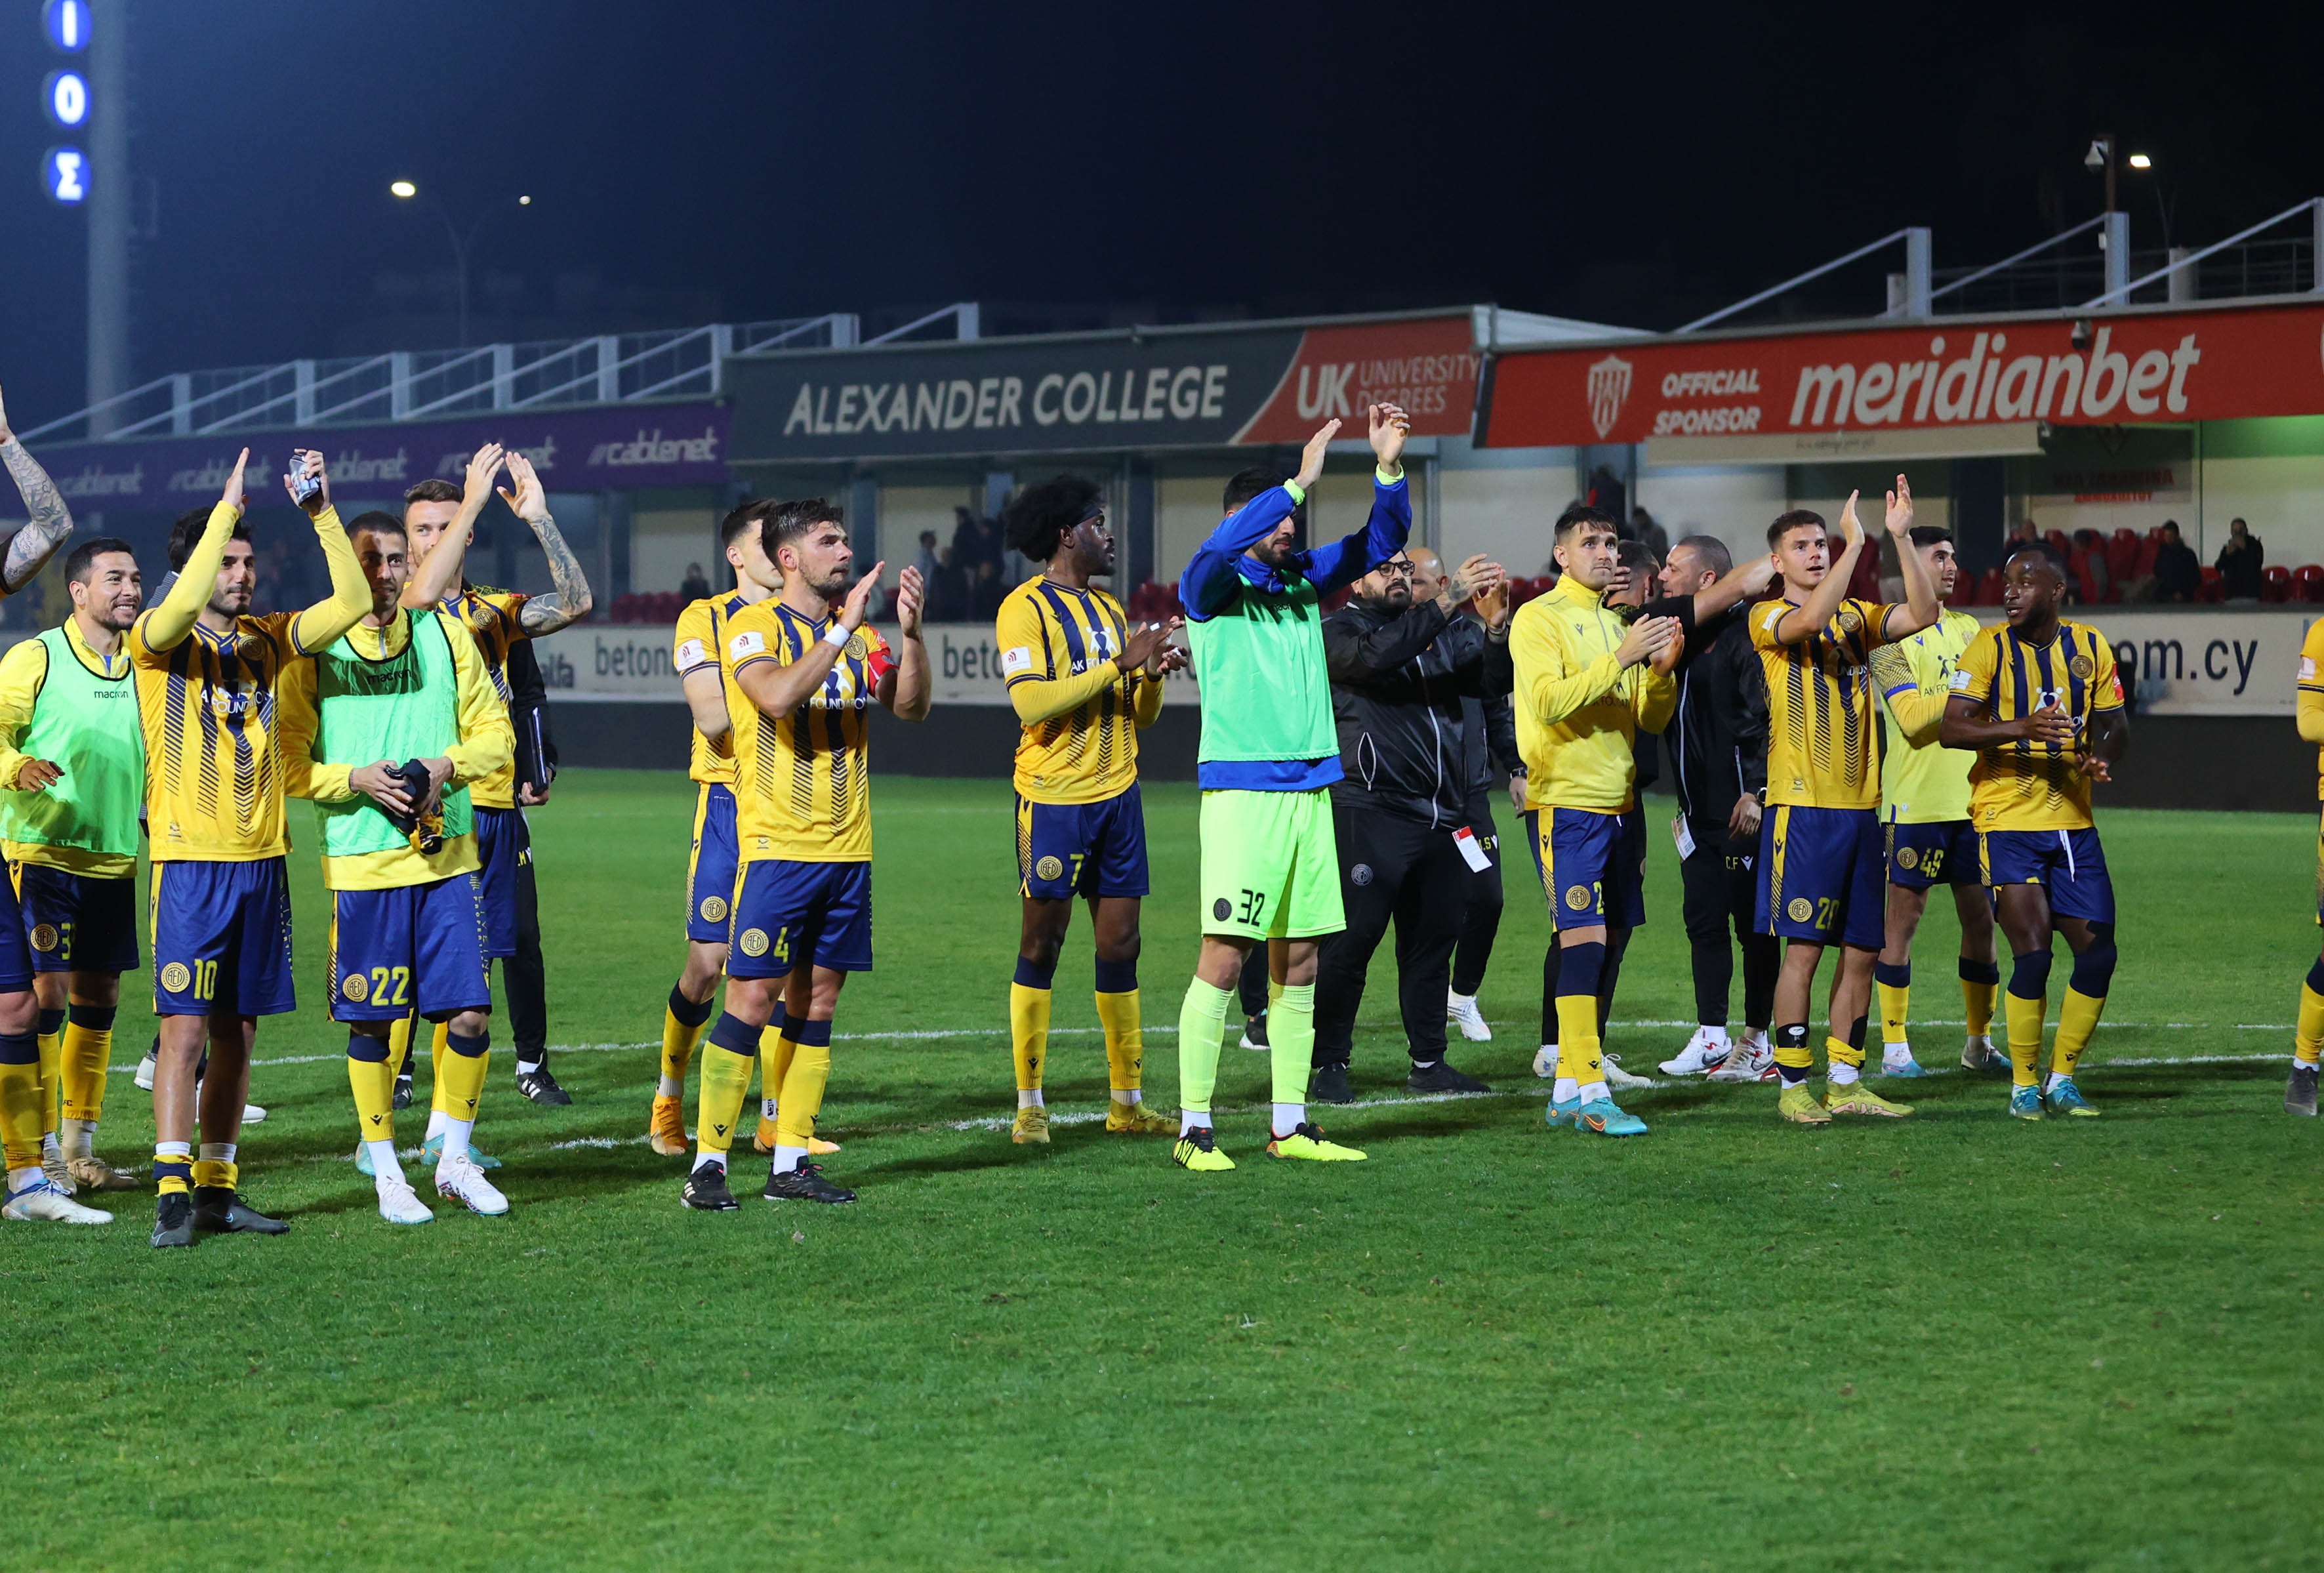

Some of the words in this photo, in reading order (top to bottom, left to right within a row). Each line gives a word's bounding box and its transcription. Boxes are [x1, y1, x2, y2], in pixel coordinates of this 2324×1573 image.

[1359, 355, 1479, 386] UNIVERSITY
[1661, 367, 1761, 398] OFFICIAL
[1789, 327, 2201, 426] meridianbet
[783, 377, 1021, 436] ALEXANDER
[1032, 365, 1228, 425] COLLEGE
[1297, 363, 1355, 420] UK
[1652, 405, 1762, 435] SPONSOR
[1070, 660, 1084, 672] AK
[1070, 853, 1084, 888] 7
[1919, 848, 1944, 878] 49
[1237, 888, 1265, 928] 32
[774, 927, 788, 964] 4
[194, 958, 218, 1001] 10
[371, 966, 410, 1006] 22
